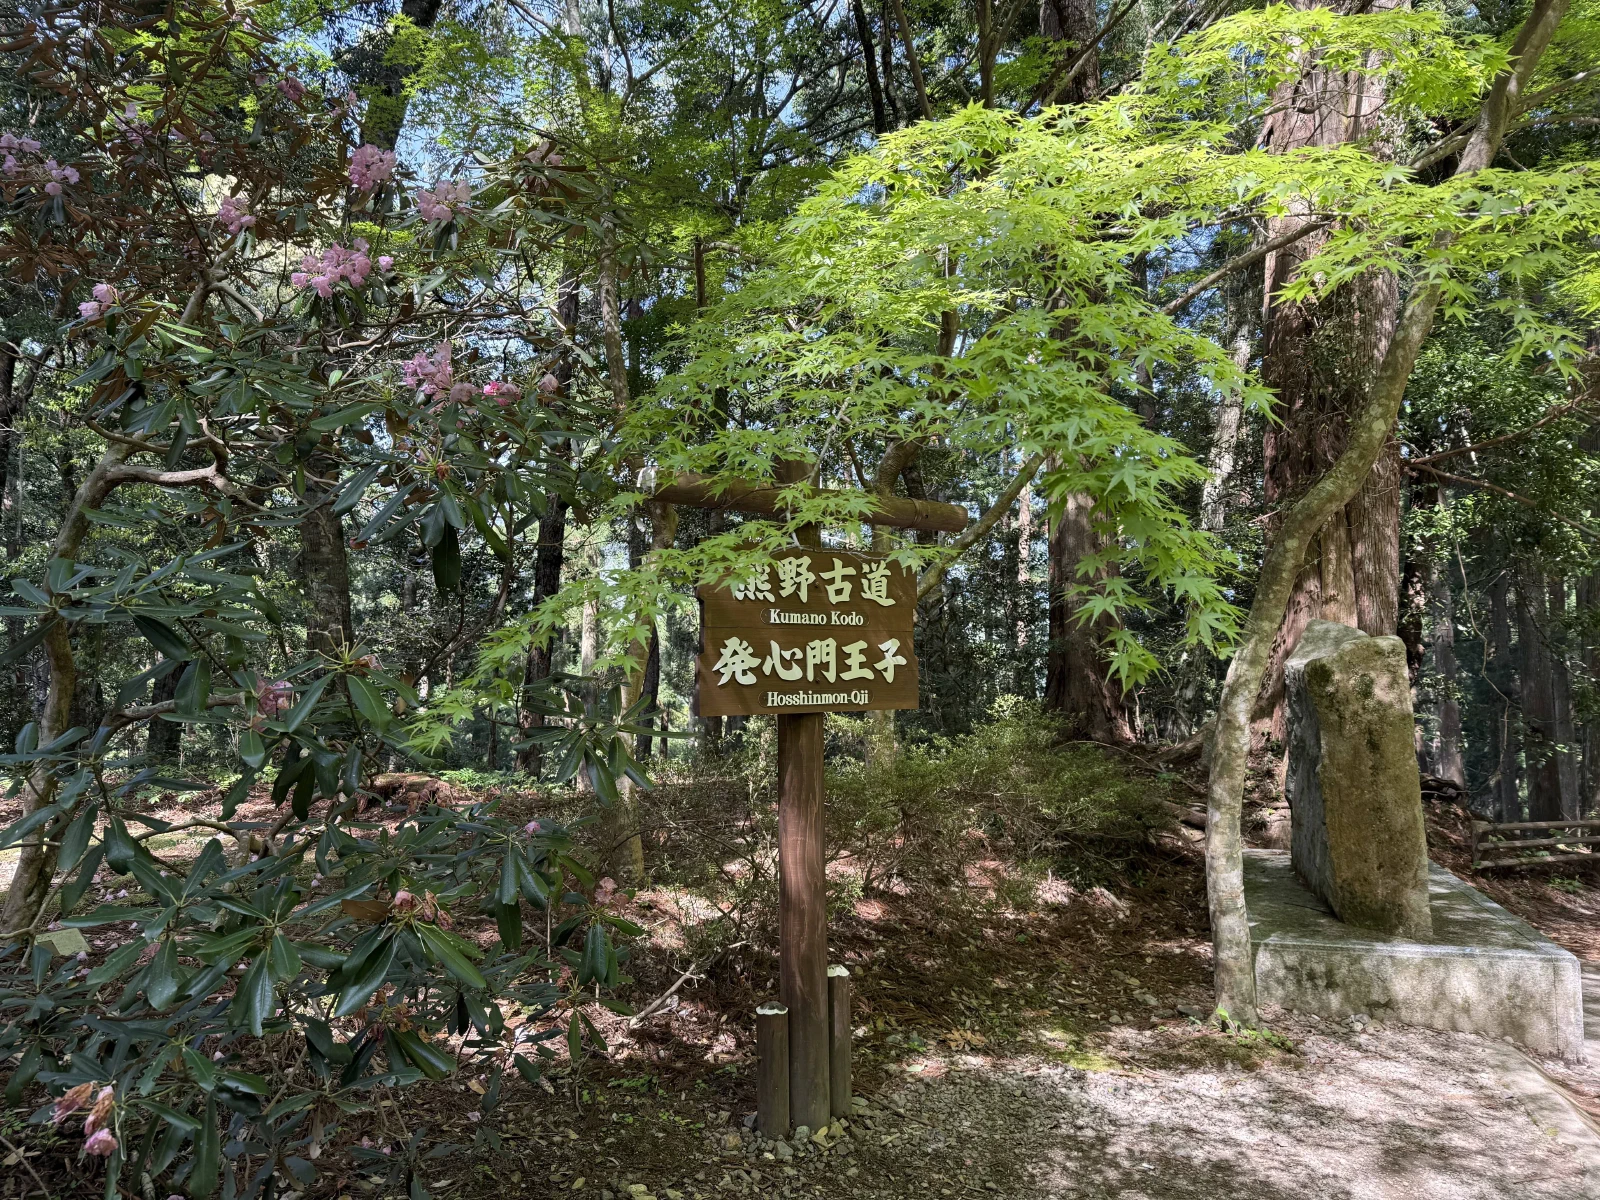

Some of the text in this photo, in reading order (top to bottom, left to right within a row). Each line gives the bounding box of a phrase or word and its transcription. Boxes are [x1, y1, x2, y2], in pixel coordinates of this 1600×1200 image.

[769, 608, 864, 626] Kumano Kodo
[712, 636, 907, 686] 発心門王子
[766, 690, 869, 706] Hosshinmon-Oji
